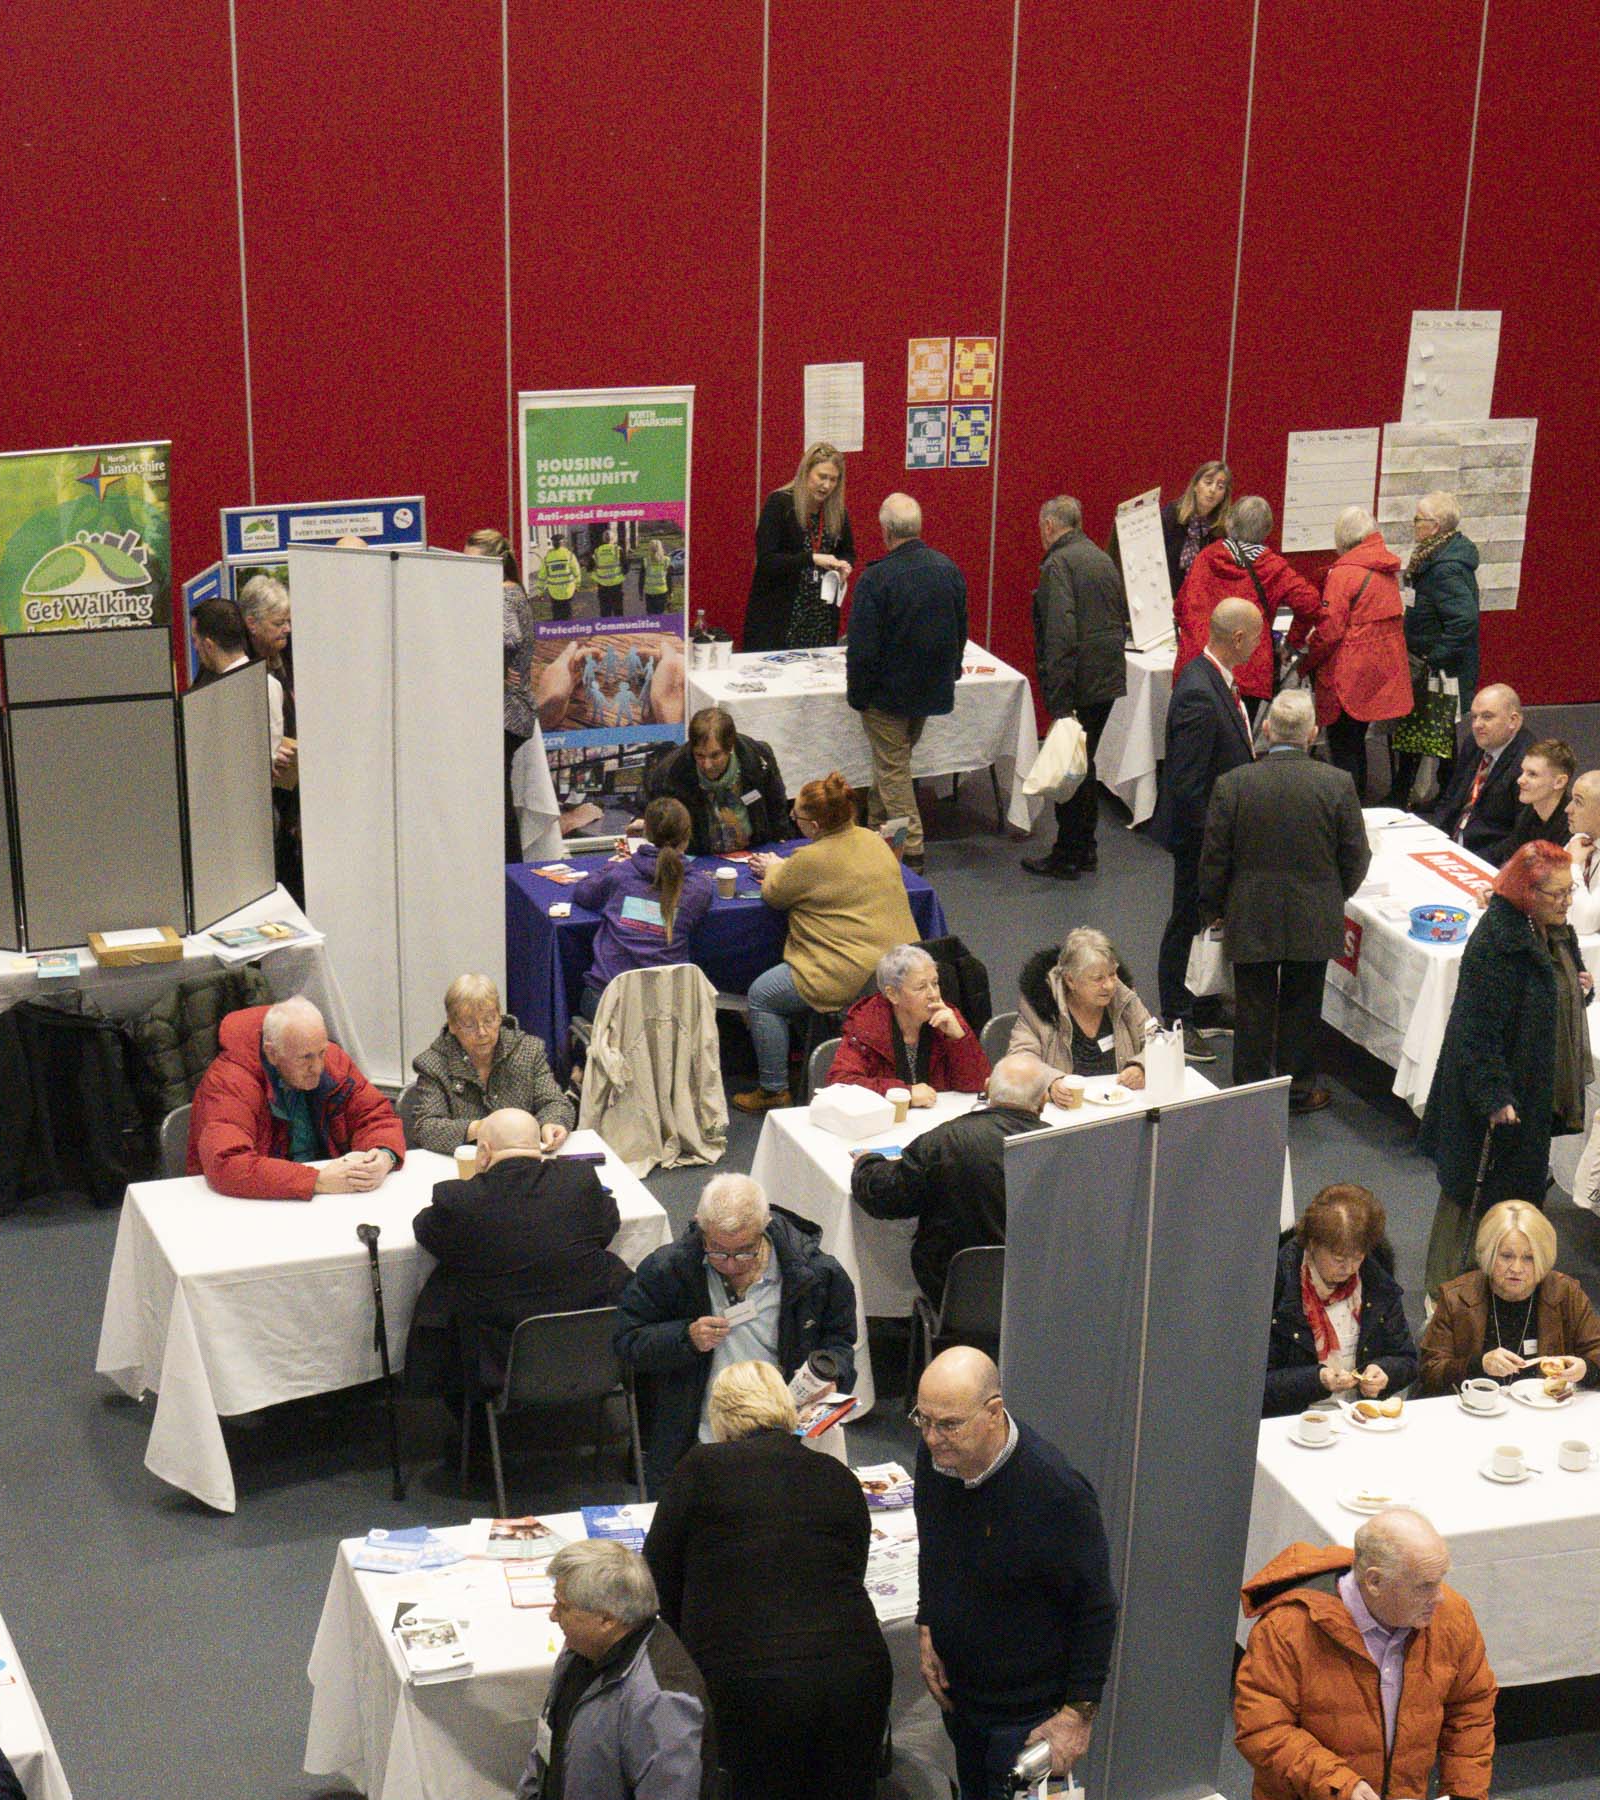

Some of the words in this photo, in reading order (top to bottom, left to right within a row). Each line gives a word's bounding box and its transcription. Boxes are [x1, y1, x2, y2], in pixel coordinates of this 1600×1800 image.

[100, 460, 166, 476] Lanarkshire
[536, 456, 616, 473] HOUSING
[536, 469, 640, 489] COMMUNITY
[536, 487, 596, 504] SAFETY
[536, 508, 594, 522] Anti-social
[596, 506, 645, 520] Response
[24, 600, 64, 624] Get
[66, 591, 154, 619] Walking
[539, 624, 593, 636] Protecting
[595, 619, 661, 631] Communities
[1423, 854, 1493, 891] MEAR
